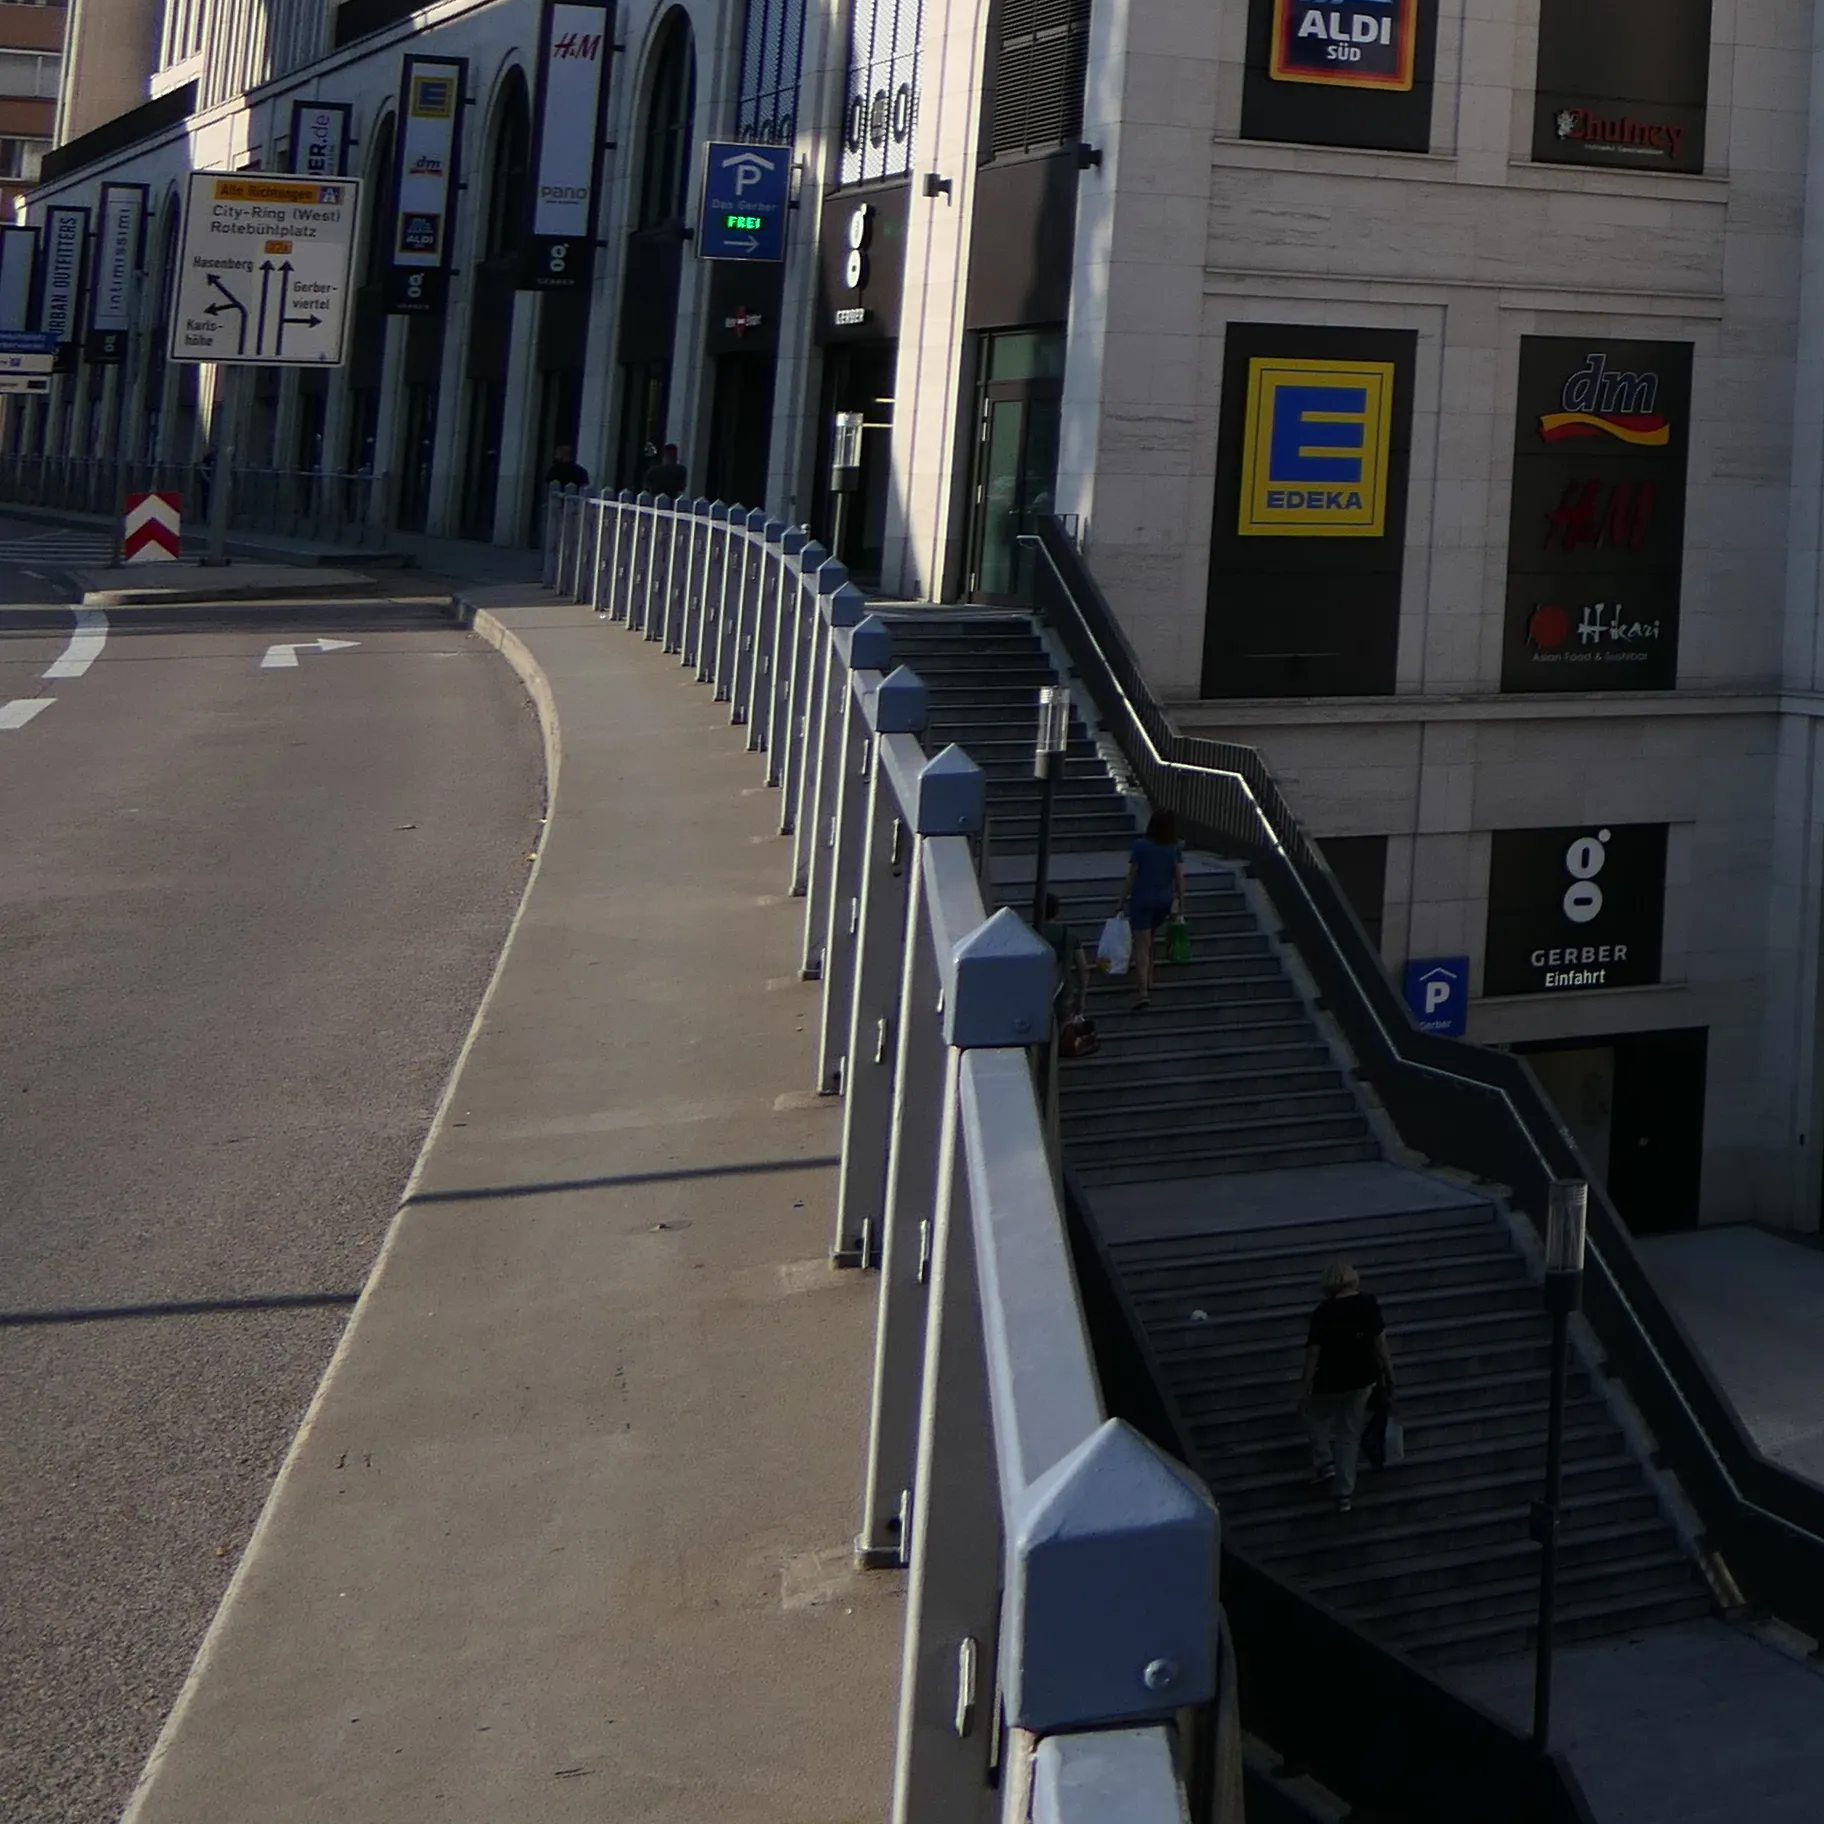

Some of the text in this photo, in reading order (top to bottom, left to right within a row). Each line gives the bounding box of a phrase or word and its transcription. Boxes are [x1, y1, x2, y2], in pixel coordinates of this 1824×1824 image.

[1298, 10, 1392, 44] ALDI
[554, 32, 602, 61] H&M
[1327, 43, 1361, 61] SÜD
[416, 156, 441, 169] dm
[736, 165, 762, 195] P
[541, 185, 589, 201] pano
[213, 204, 341, 223] City-Ring (West)
[727, 216, 761, 229] FREI
[211, 221, 317, 238] Rotebühlplatz
[53, 217, 77, 287] OUTFITTERS
[193, 256, 255, 273] Hasenberg
[293, 281, 338, 294] Gerber-
[292, 298, 331, 310] viertel
[186, 318, 224, 331] Karls-
[184, 333, 213, 346] höhe
[1562, 353, 1659, 414] dm
[1266, 490, 1363, 510] EDEKA
[1577, 602, 1661, 646] Hikari
[1532, 651, 1562, 663] Asian
[1565, 651, 1592, 662] Food
[1530, 943, 1629, 968] GERBER
[1544, 967, 1606, 988] Einfahrt
[1425, 980, 1450, 1014] P
